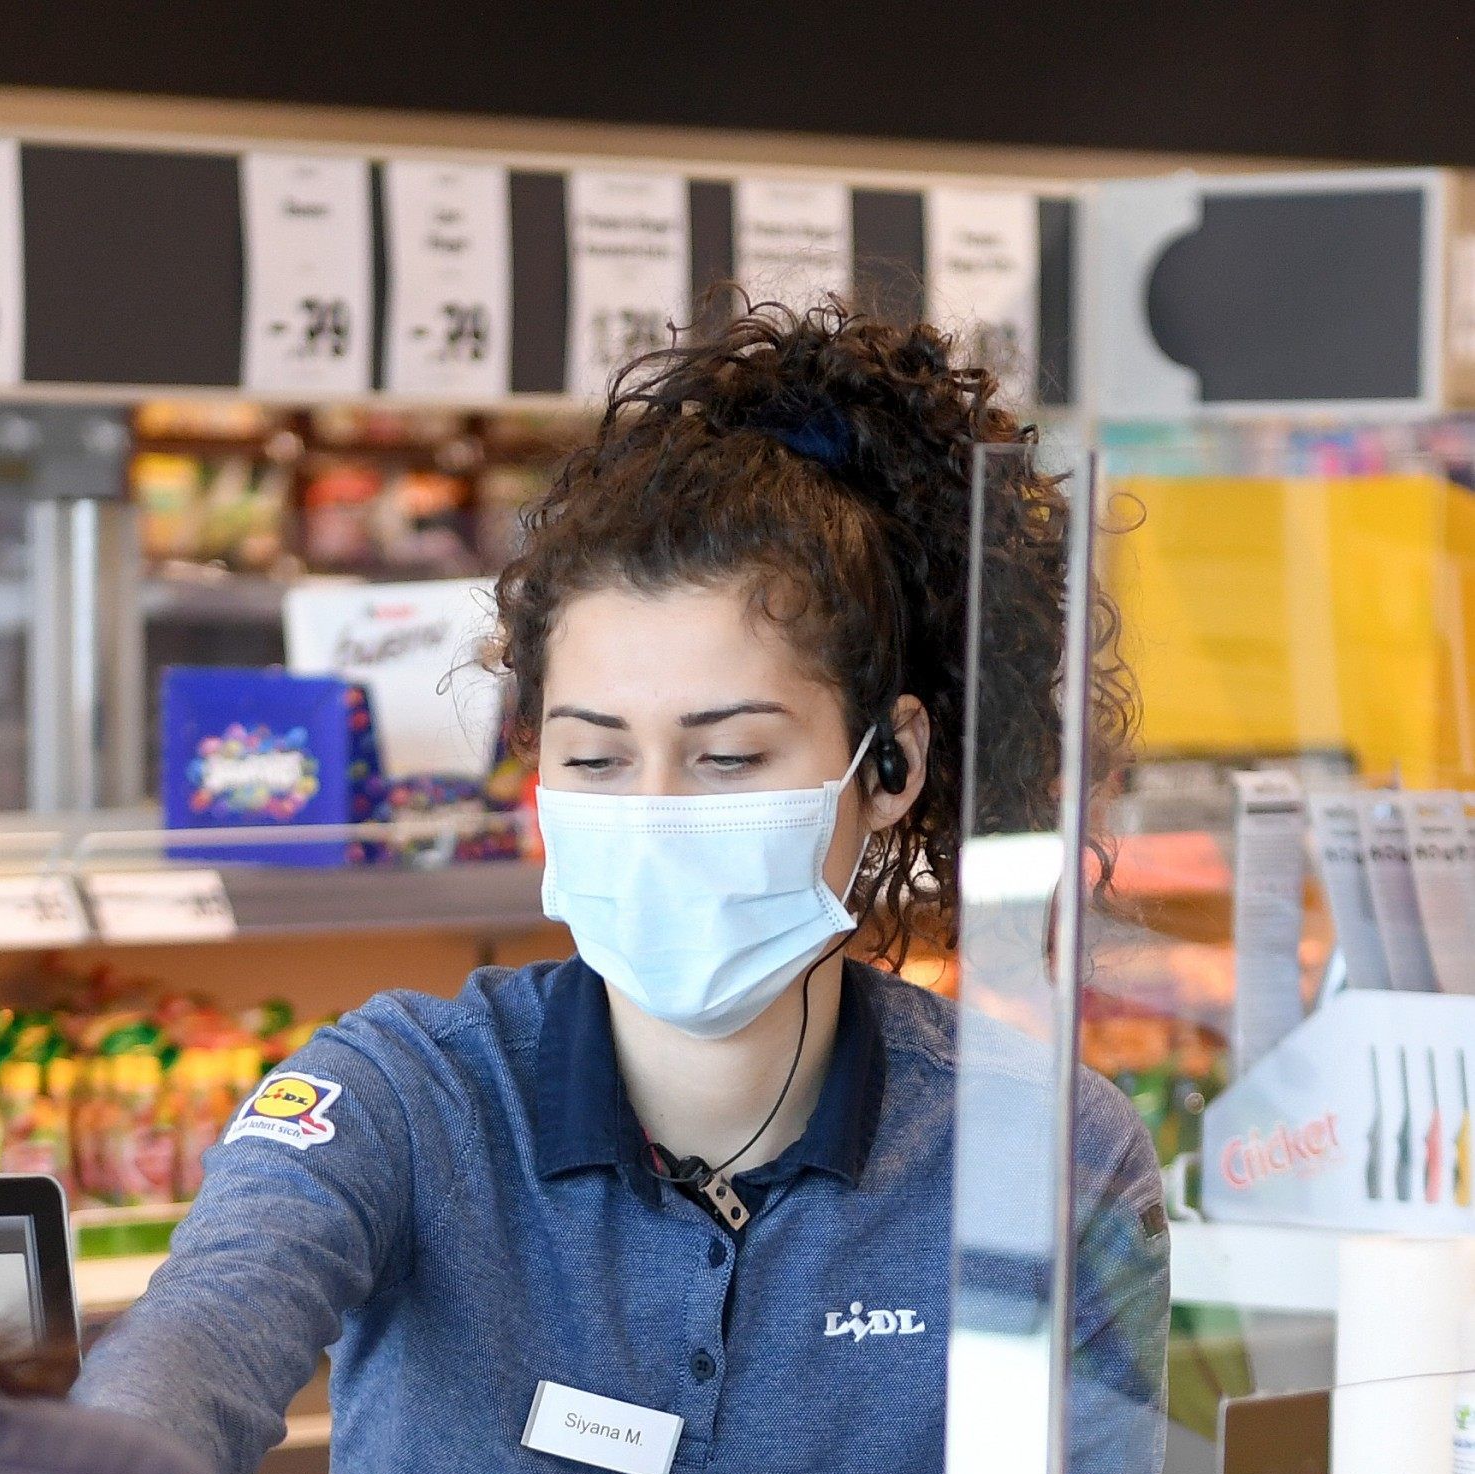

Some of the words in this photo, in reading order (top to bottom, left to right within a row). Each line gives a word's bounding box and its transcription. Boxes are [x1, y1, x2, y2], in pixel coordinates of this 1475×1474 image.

[248, 1120, 276, 1131] lohnt
[278, 1126, 302, 1140] sich.
[1220, 1112, 1338, 1190] Cricket
[563, 1411, 620, 1442] Siyana
[624, 1426, 644, 1447] M.
